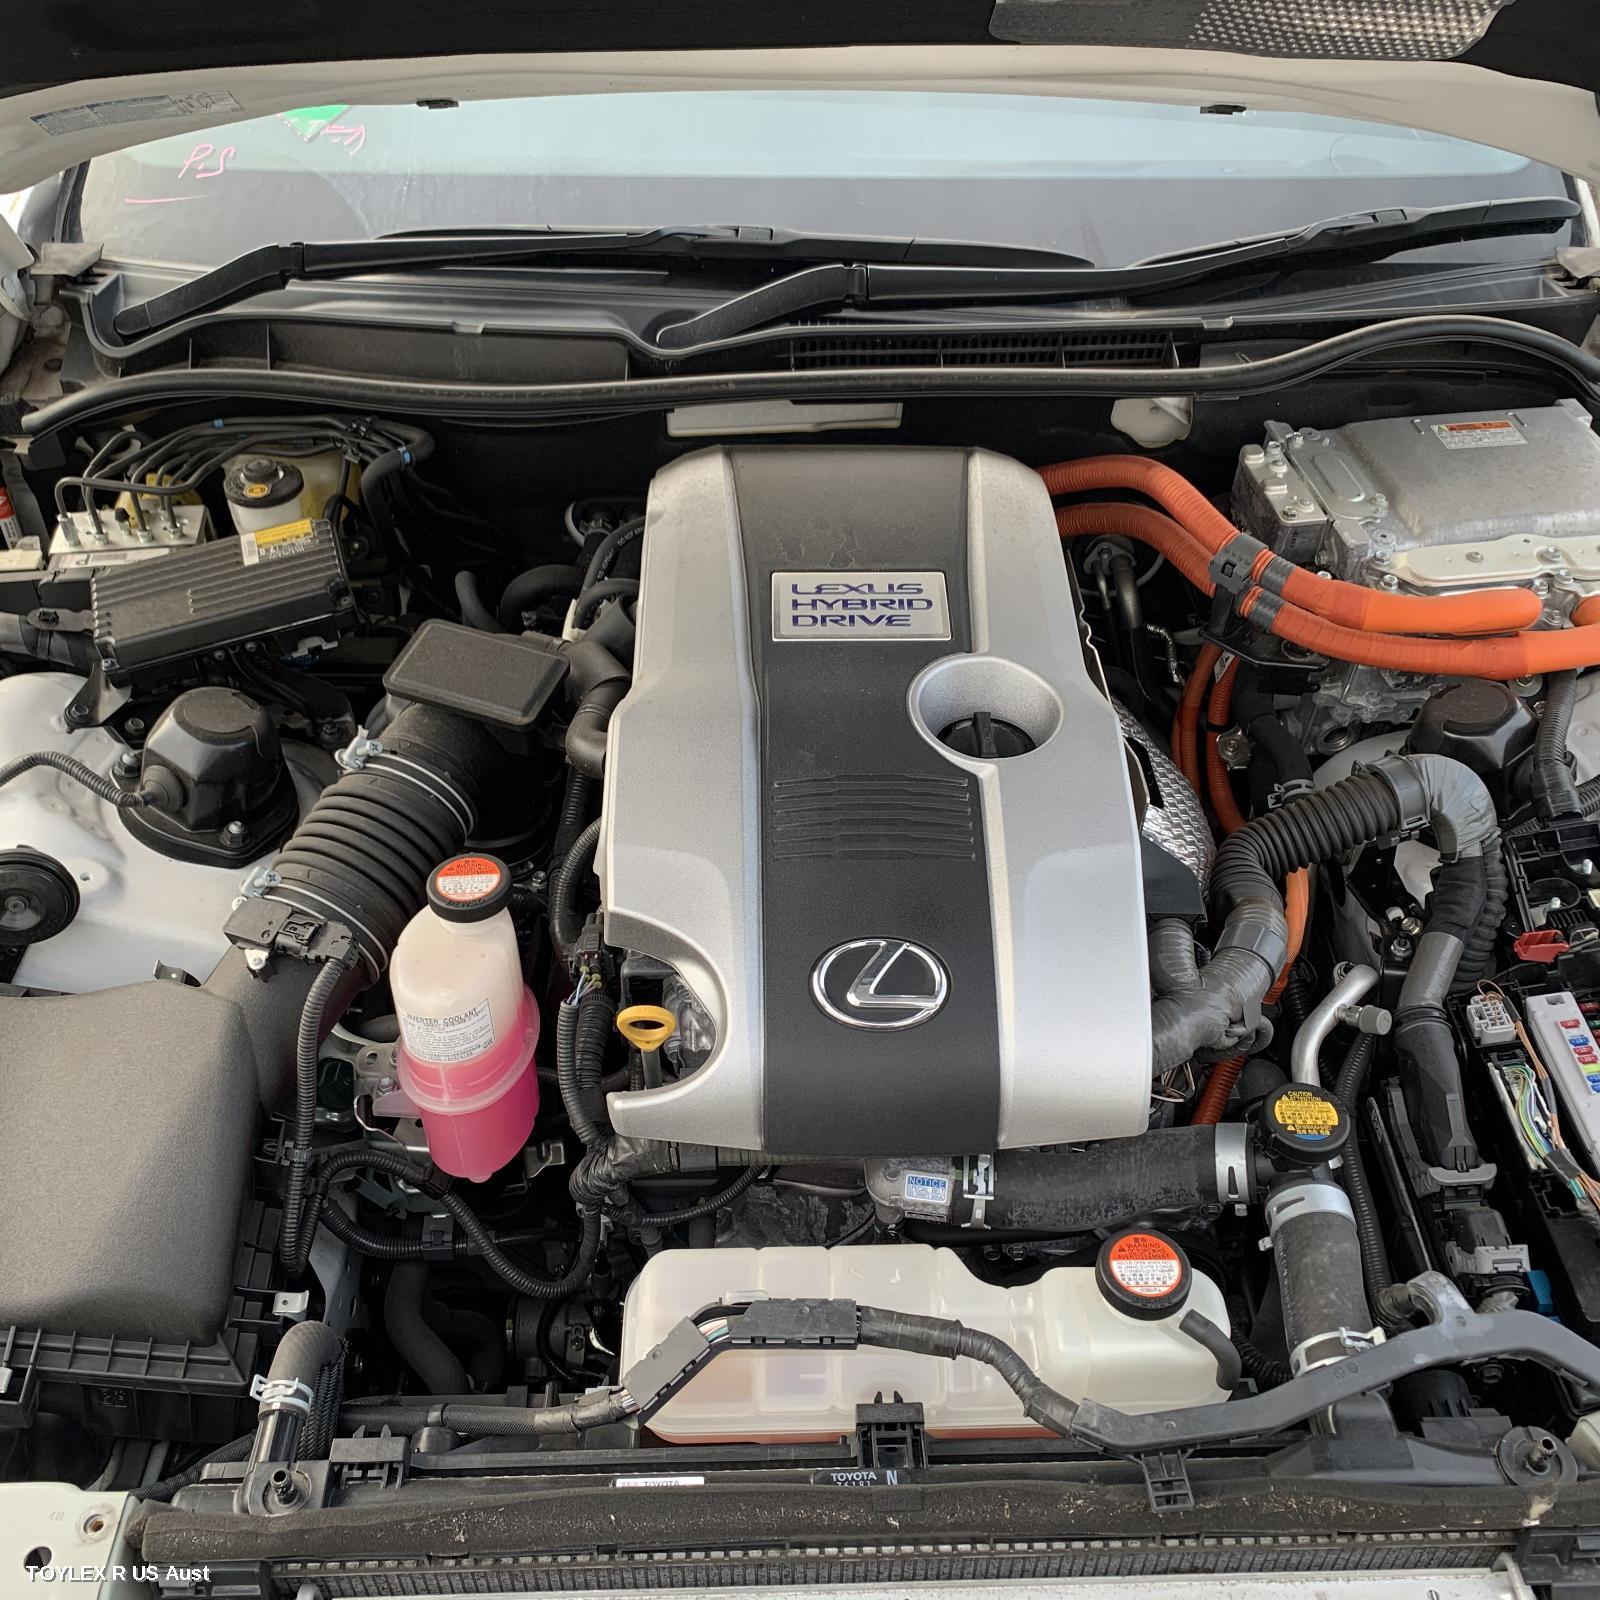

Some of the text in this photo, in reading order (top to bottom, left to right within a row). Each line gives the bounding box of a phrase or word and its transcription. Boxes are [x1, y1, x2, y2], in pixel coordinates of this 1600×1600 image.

[791, 583, 924, 595] LEXUS
[791, 598, 934, 611] HYBRID
[791, 614, 912, 627] DRIVE
[443, 1007, 477, 1025] COOLANT
[909, 1177, 945, 1188] NOTICE
[830, 1469, 898, 1486] TOYOTA N
